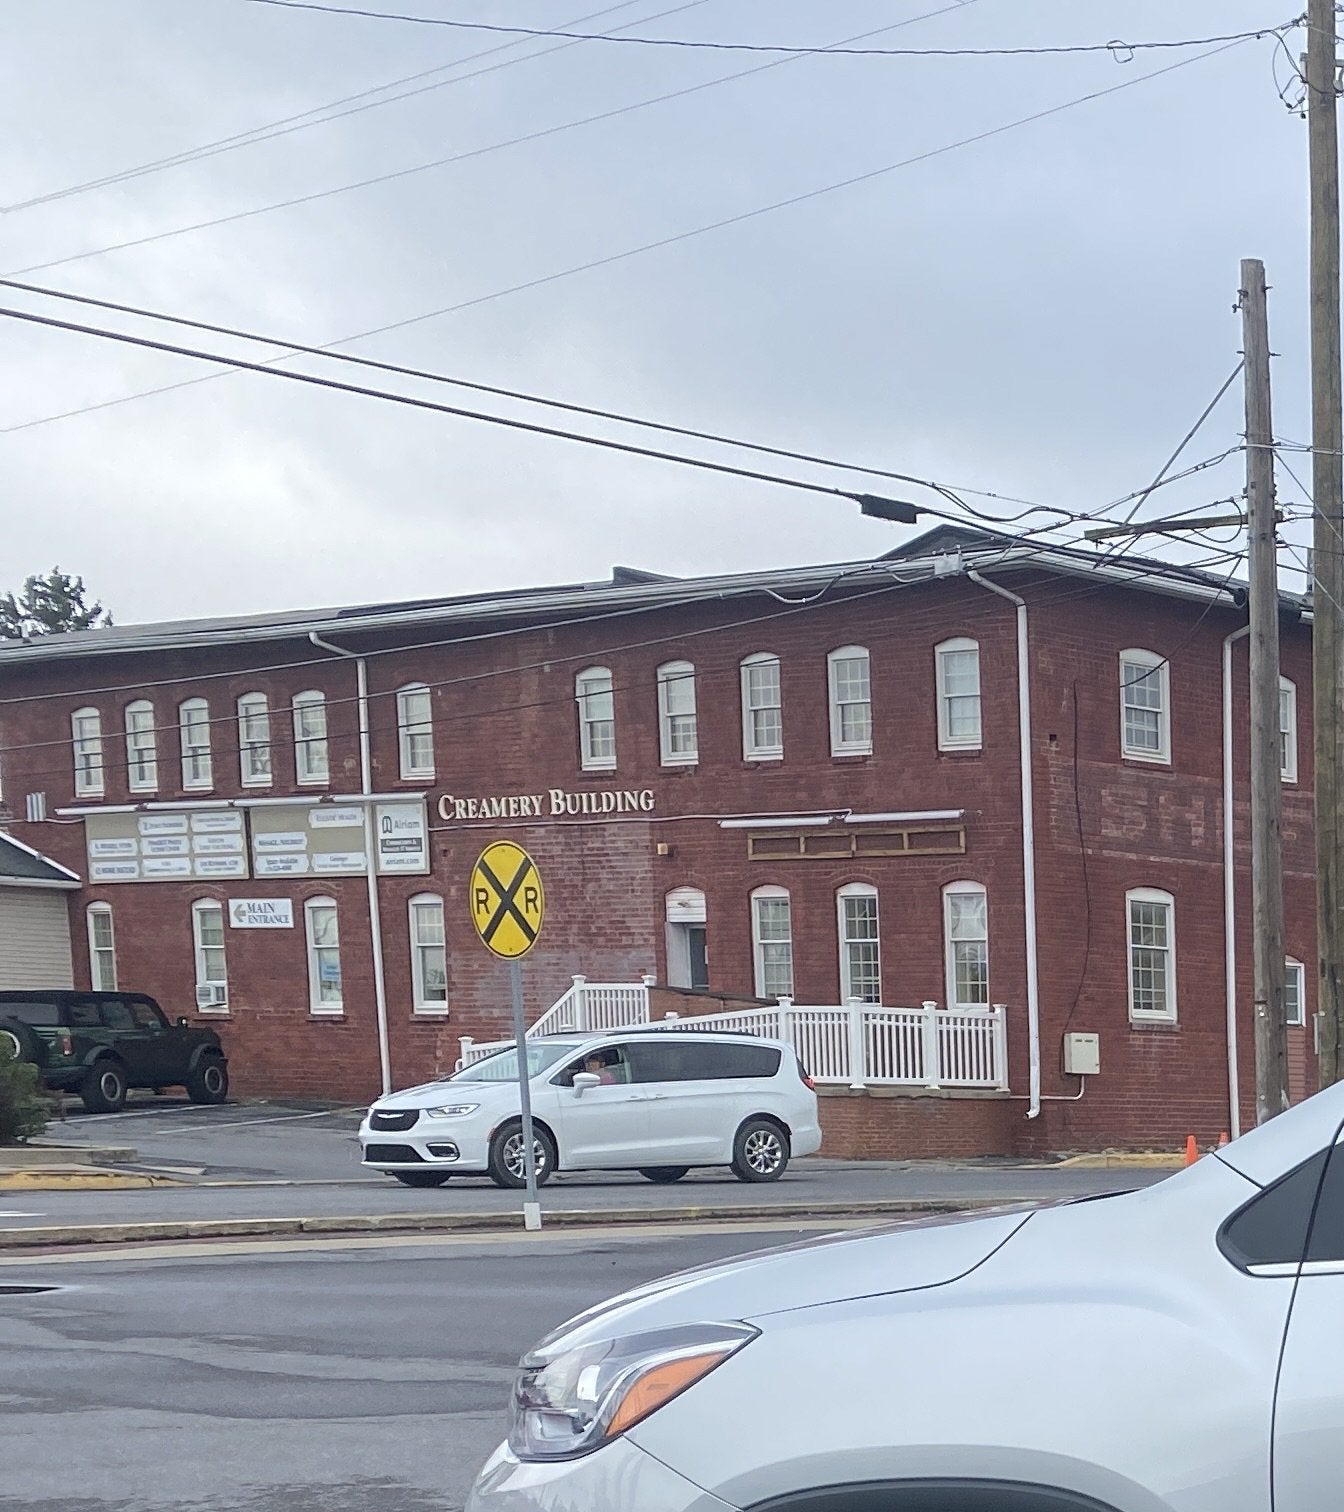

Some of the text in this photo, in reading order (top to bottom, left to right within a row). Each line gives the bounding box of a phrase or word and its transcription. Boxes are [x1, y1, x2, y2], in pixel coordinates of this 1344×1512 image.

[438, 788, 656, 820] CREAMERY BUILDING
[246, 902, 275, 914] MAIN
[475, 886, 539, 915] R R
[248, 914, 290, 924] ENTRANCE
